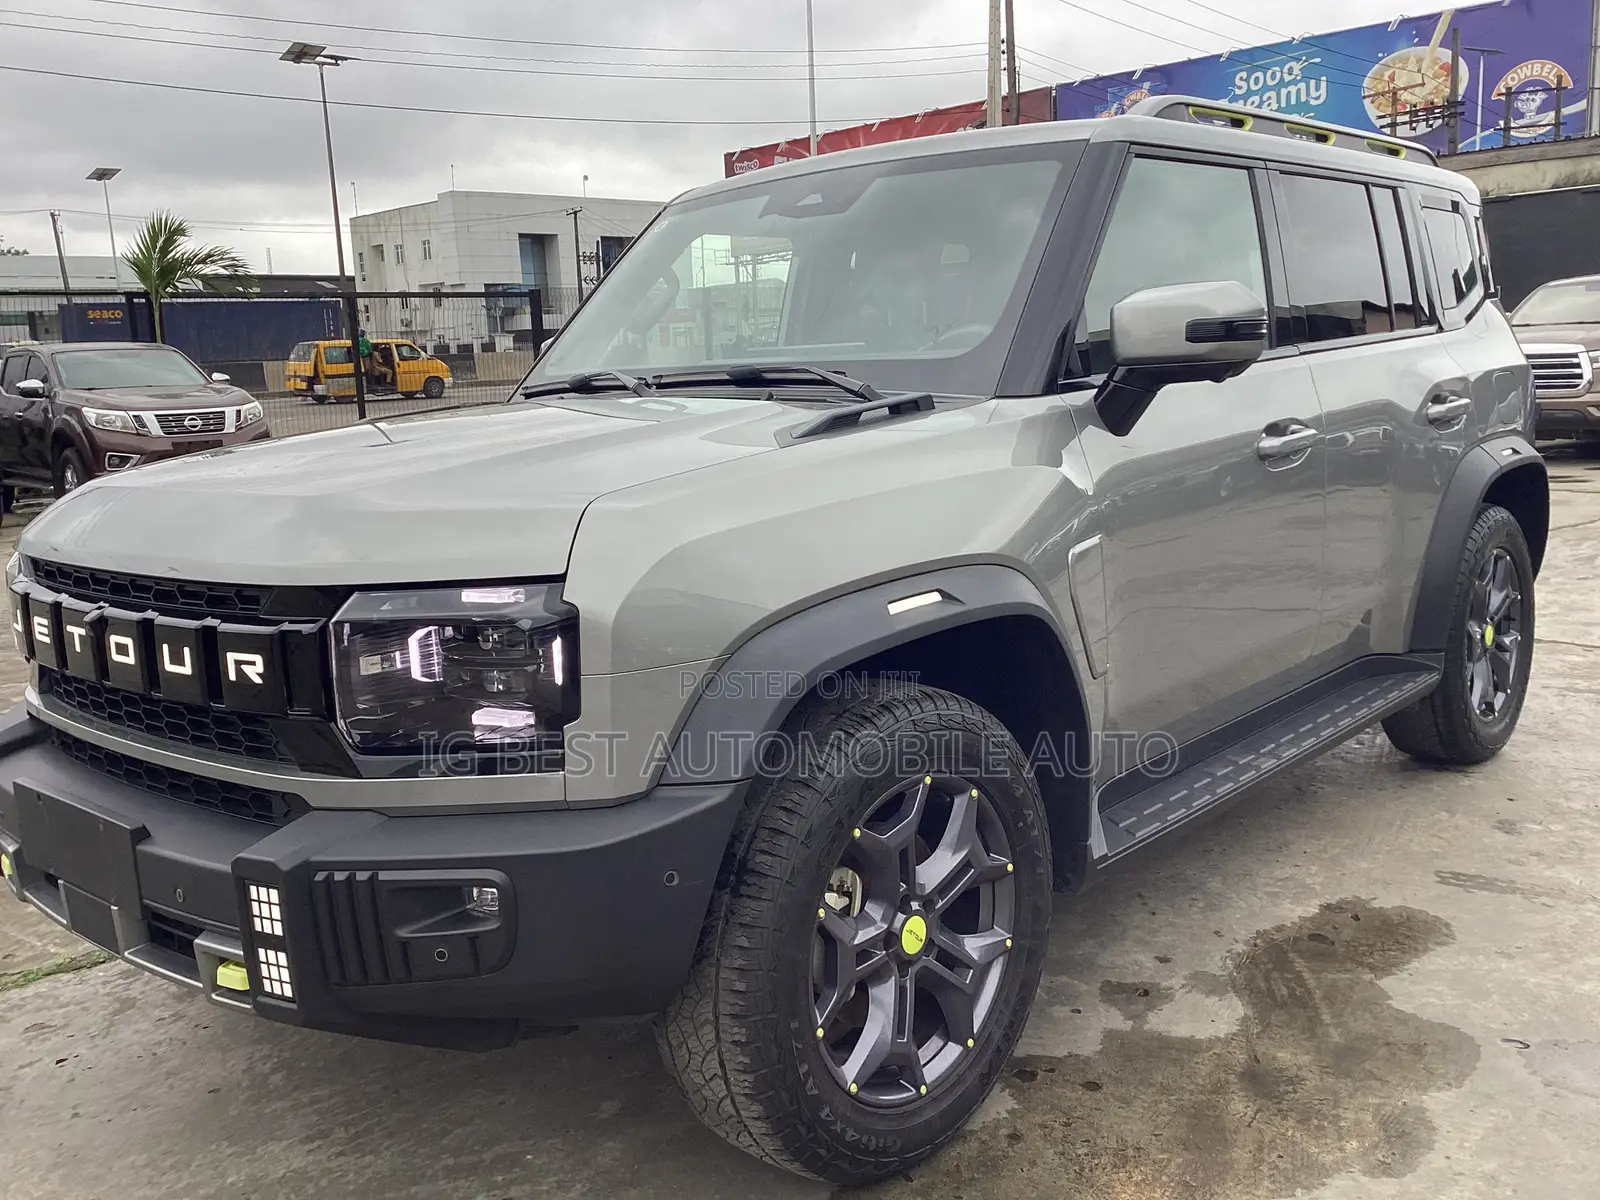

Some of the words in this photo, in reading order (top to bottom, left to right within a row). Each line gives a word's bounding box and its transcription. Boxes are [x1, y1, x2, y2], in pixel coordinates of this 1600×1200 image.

[734, 159, 759, 173] twisco
[87, 310, 123, 319] seaco
[13, 609, 264, 684] JETOUR
